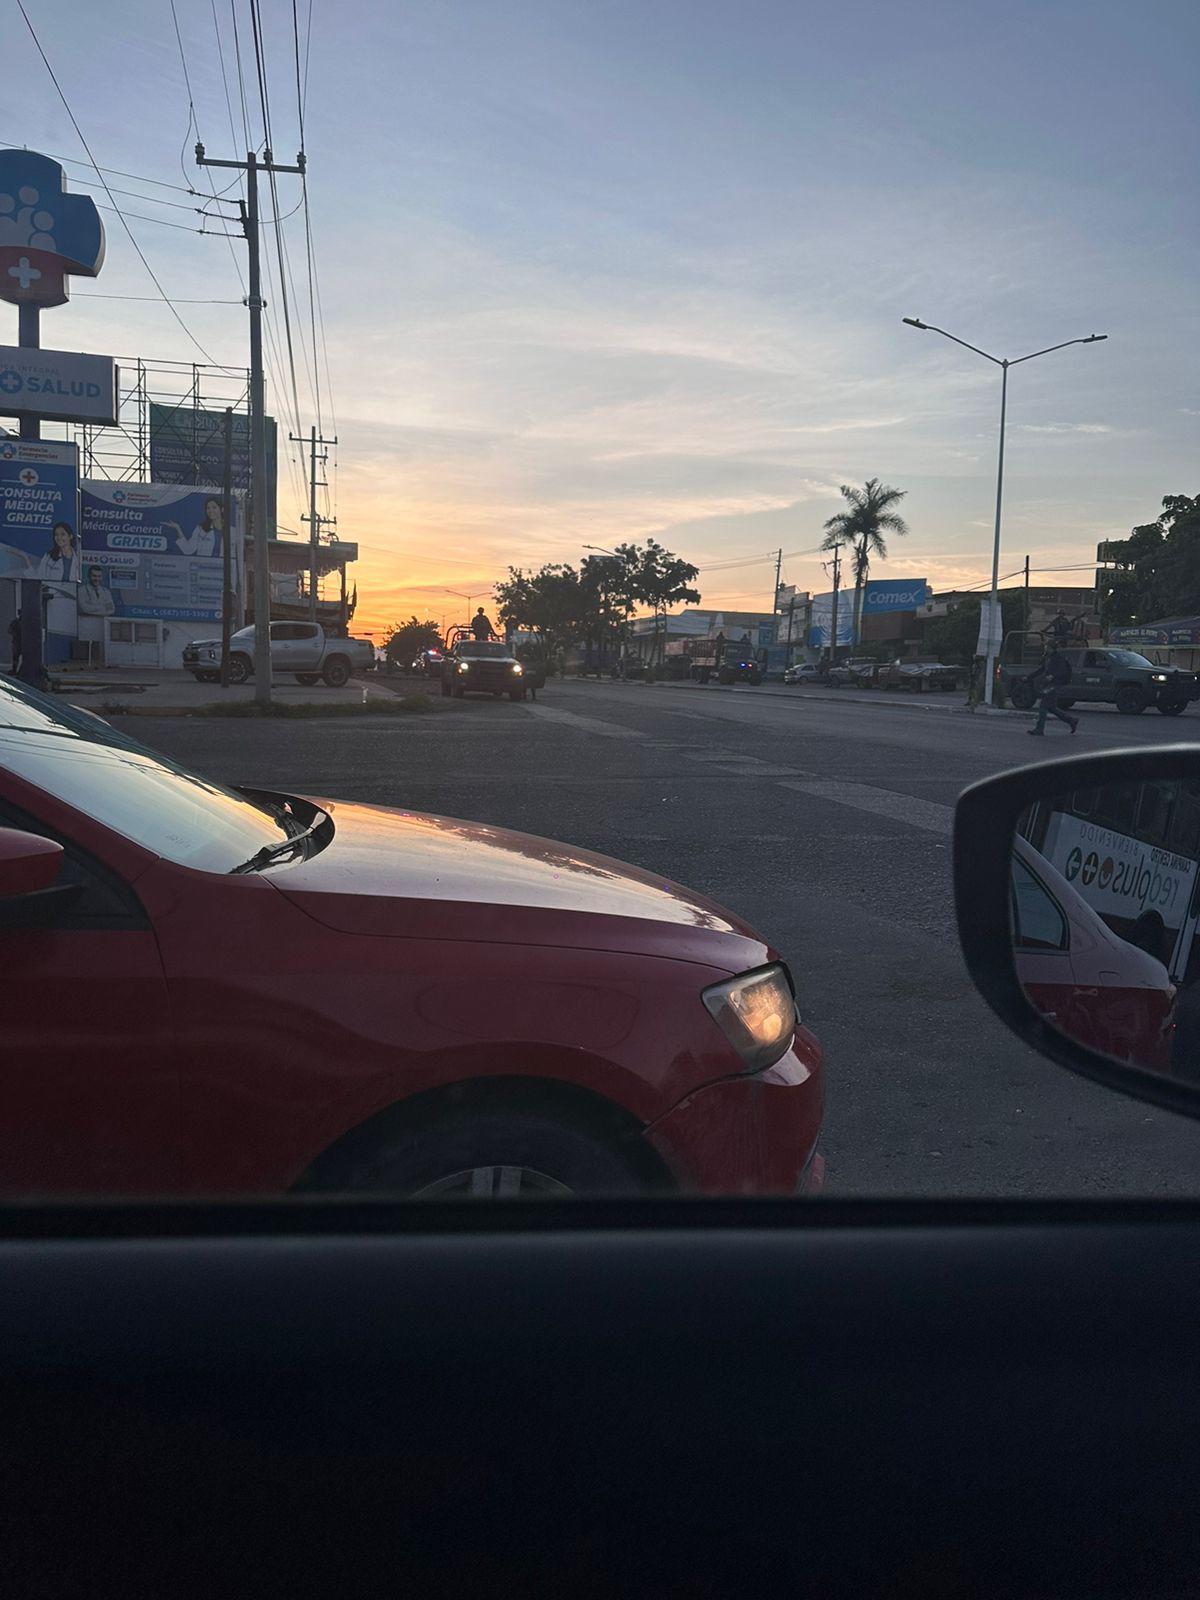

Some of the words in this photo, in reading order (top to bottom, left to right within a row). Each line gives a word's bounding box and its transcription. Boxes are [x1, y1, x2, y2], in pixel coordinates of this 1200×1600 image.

[26, 376, 101, 398] SALUD
[0, 486, 62, 502] CONSULTA
[4, 498, 55, 513] MÉDICA
[6, 512, 53, 525] GRATIS
[83, 506, 144, 521] Consulta
[122, 523, 163, 534] General
[112, 535, 162, 549] GRATIS
[109, 557, 135, 565] SALUD
[867, 588, 922, 605] Comex
